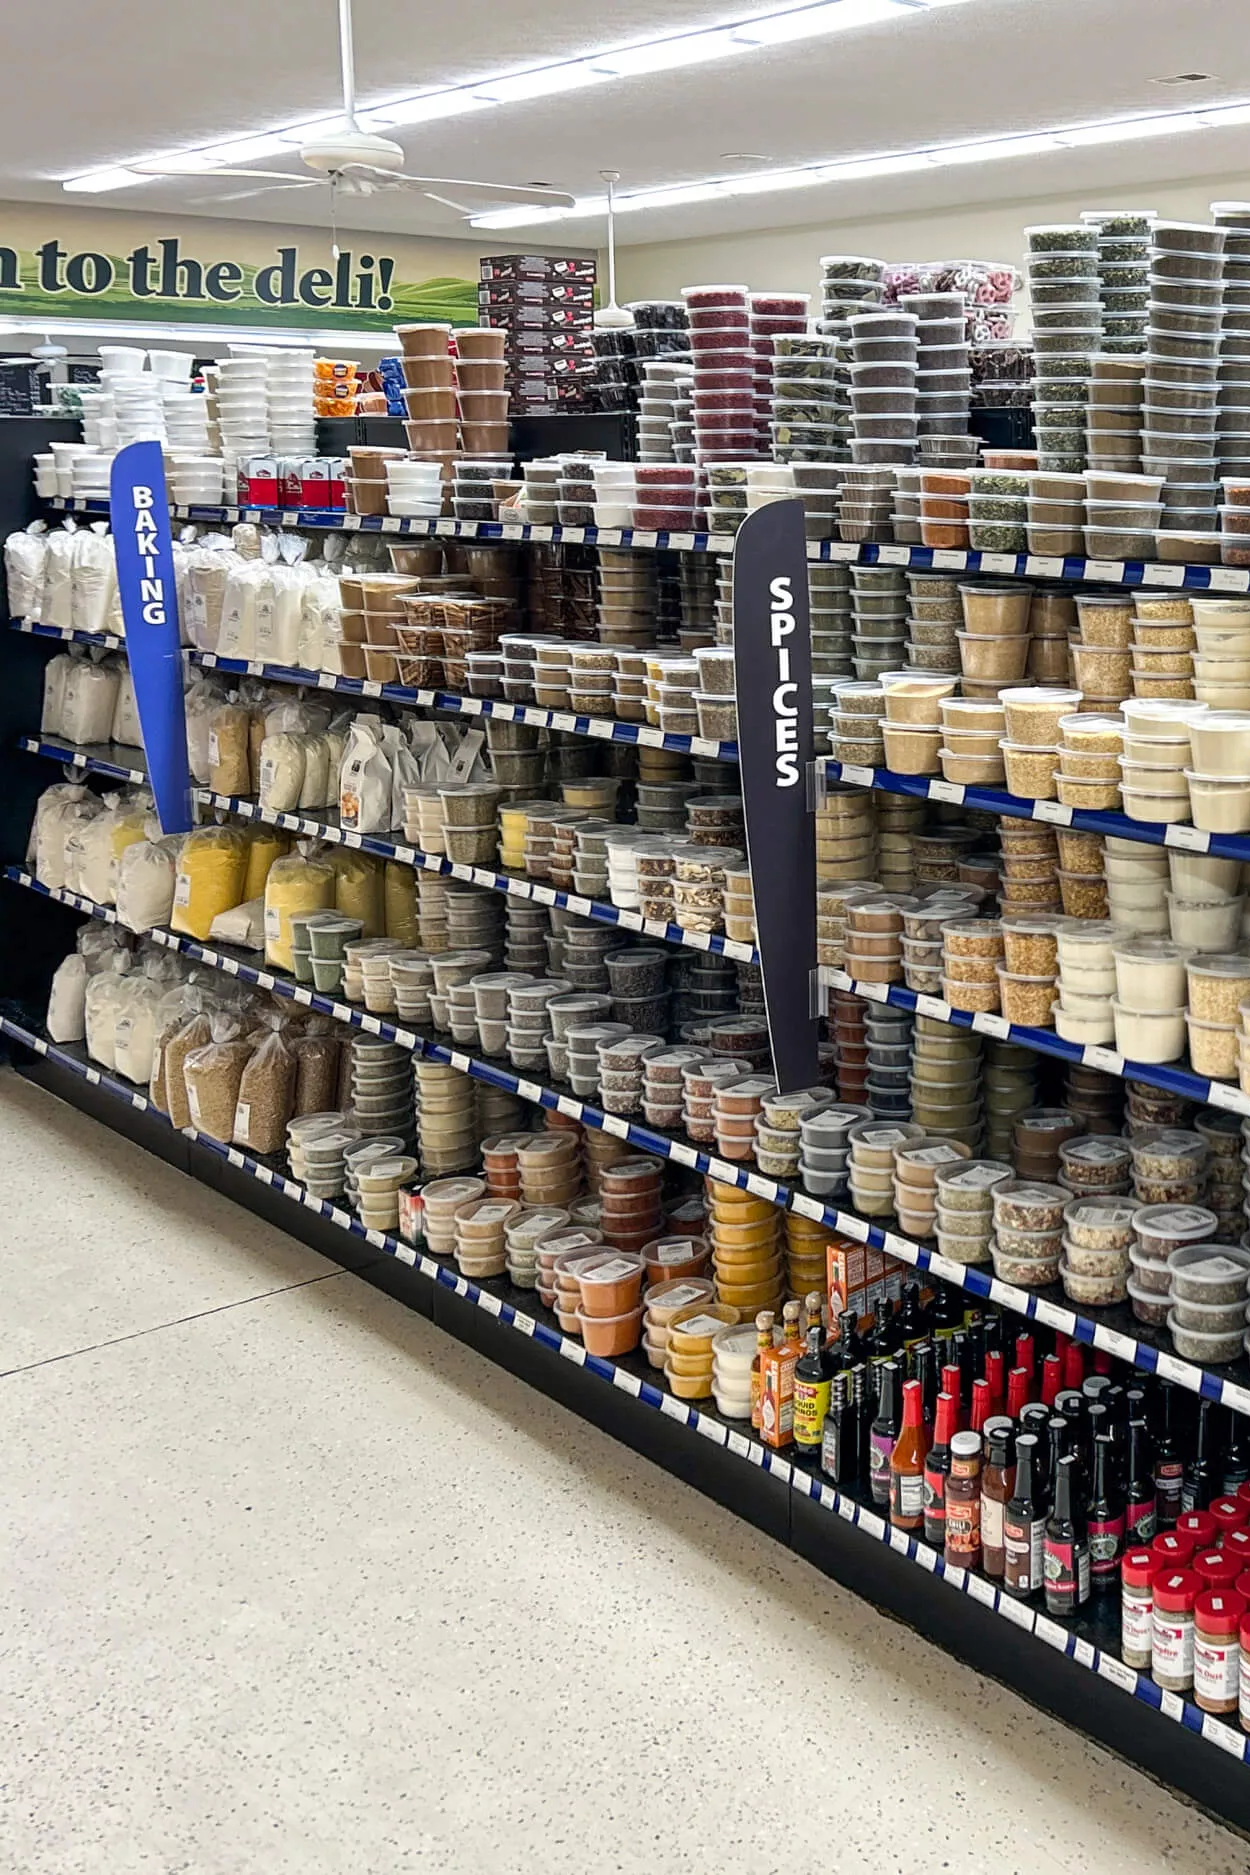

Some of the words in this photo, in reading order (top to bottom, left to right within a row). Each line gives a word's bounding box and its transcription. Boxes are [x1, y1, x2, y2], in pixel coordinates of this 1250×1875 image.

[36, 240, 113, 294] to
[127, 238, 243, 301] the
[255, 247, 395, 311] deli!
[132, 485, 167, 625] BAKING
[769, 576, 800, 788] SPICES
